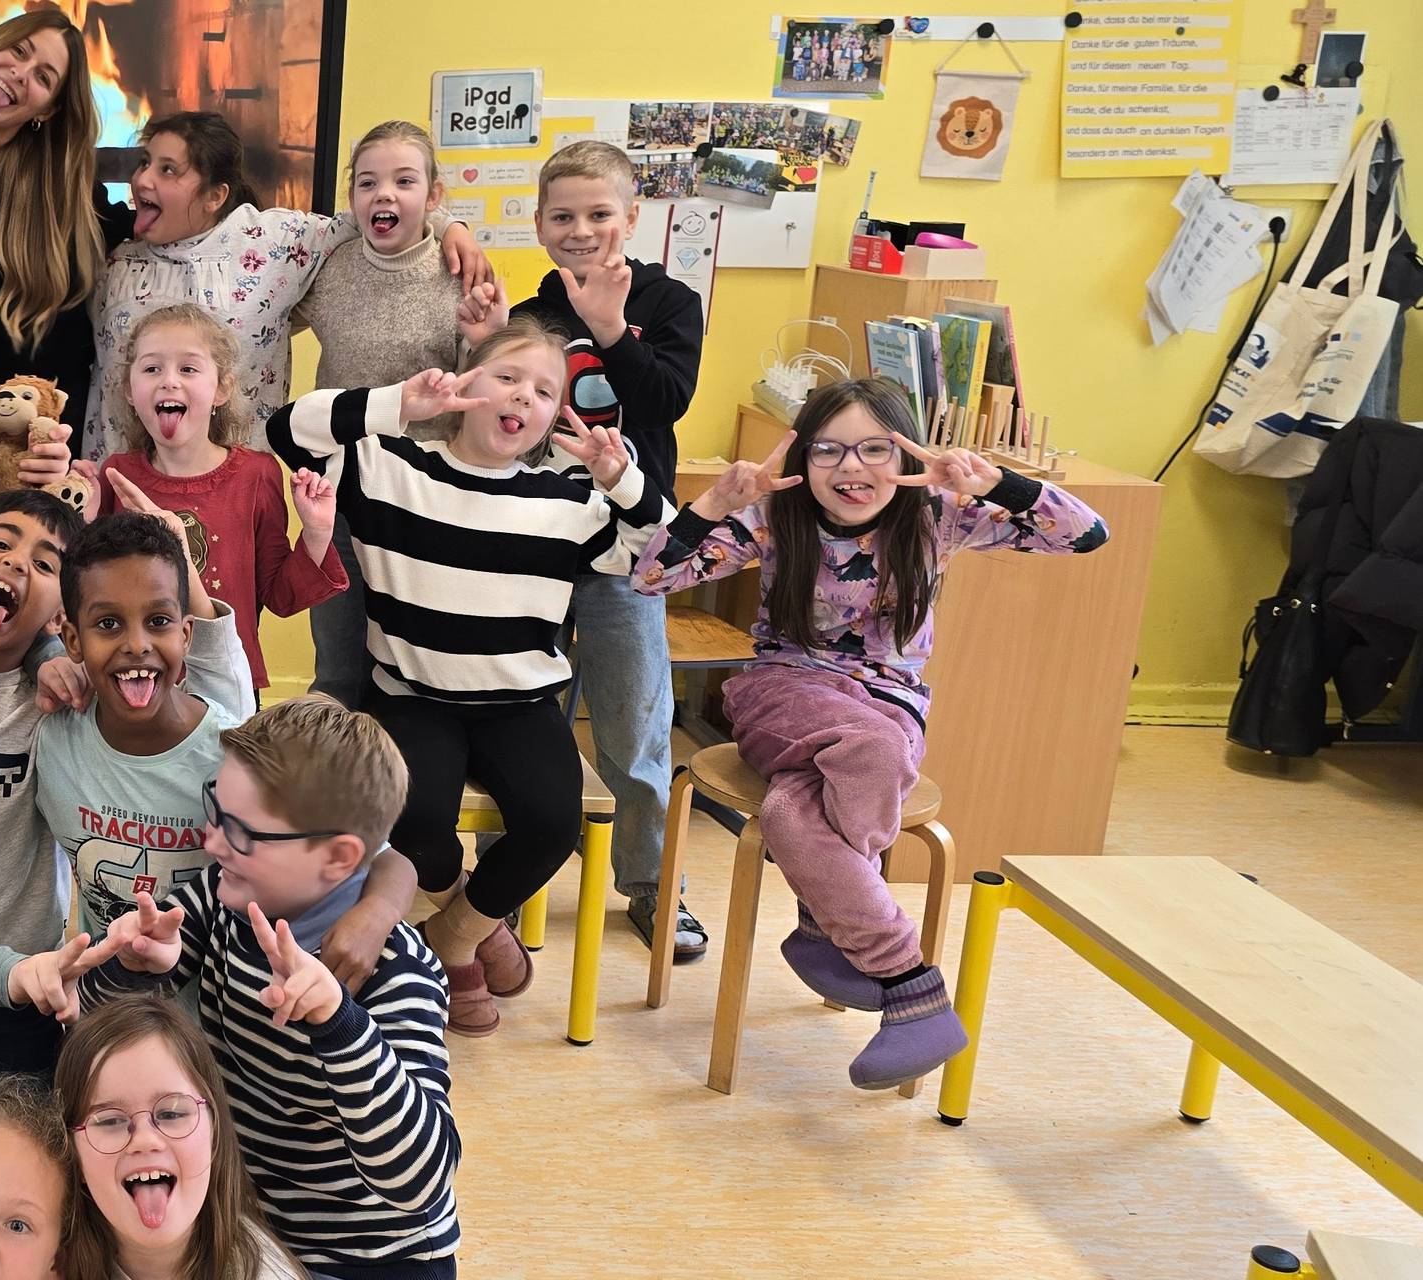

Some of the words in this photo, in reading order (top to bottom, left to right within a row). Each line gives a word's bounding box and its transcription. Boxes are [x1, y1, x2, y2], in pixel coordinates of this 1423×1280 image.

[1104, 16, 1126, 24] dass
[1128, 15, 1140, 24] du
[1142, 15, 1155, 24] bei
[1158, 15, 1171, 24] mir
[1071, 40, 1100, 49] Danke
[1102, 39, 1114, 48] für
[1115, 39, 1130, 48] die
[1134, 38, 1160, 49] guten
[1070, 62, 1088, 70] und
[1089, 61, 1100, 70] für
[1102, 61, 1132, 70] diesen
[1137, 62, 1166, 70] neuen
[1098, 83, 1110, 93] für
[1112, 83, 1139, 92] meine
[1178, 83, 1190, 92] für
[1193, 83, 1208, 92] die
[465, 86, 511, 107] iPad
[1098, 105, 1112, 114] die
[1114, 105, 1125, 114] du
[450, 110, 523, 134] Regeln
[1066, 126, 1080, 135] und
[1081, 126, 1101, 134] dass
[1102, 126, 1113, 134] du
[1115, 125, 1137, 134] auch
[1140, 127, 1152, 135] an
[1193, 125, 1225, 136] Tagen
[1066, 148, 1106, 158] besonders
[1108, 149, 1119, 157] an
[1121, 147, 1144, 157] mich
[101, 804, 128, 819] SPEED
[132, 811, 194, 828] REVOLUTION
[136, 880, 152, 892] 73
